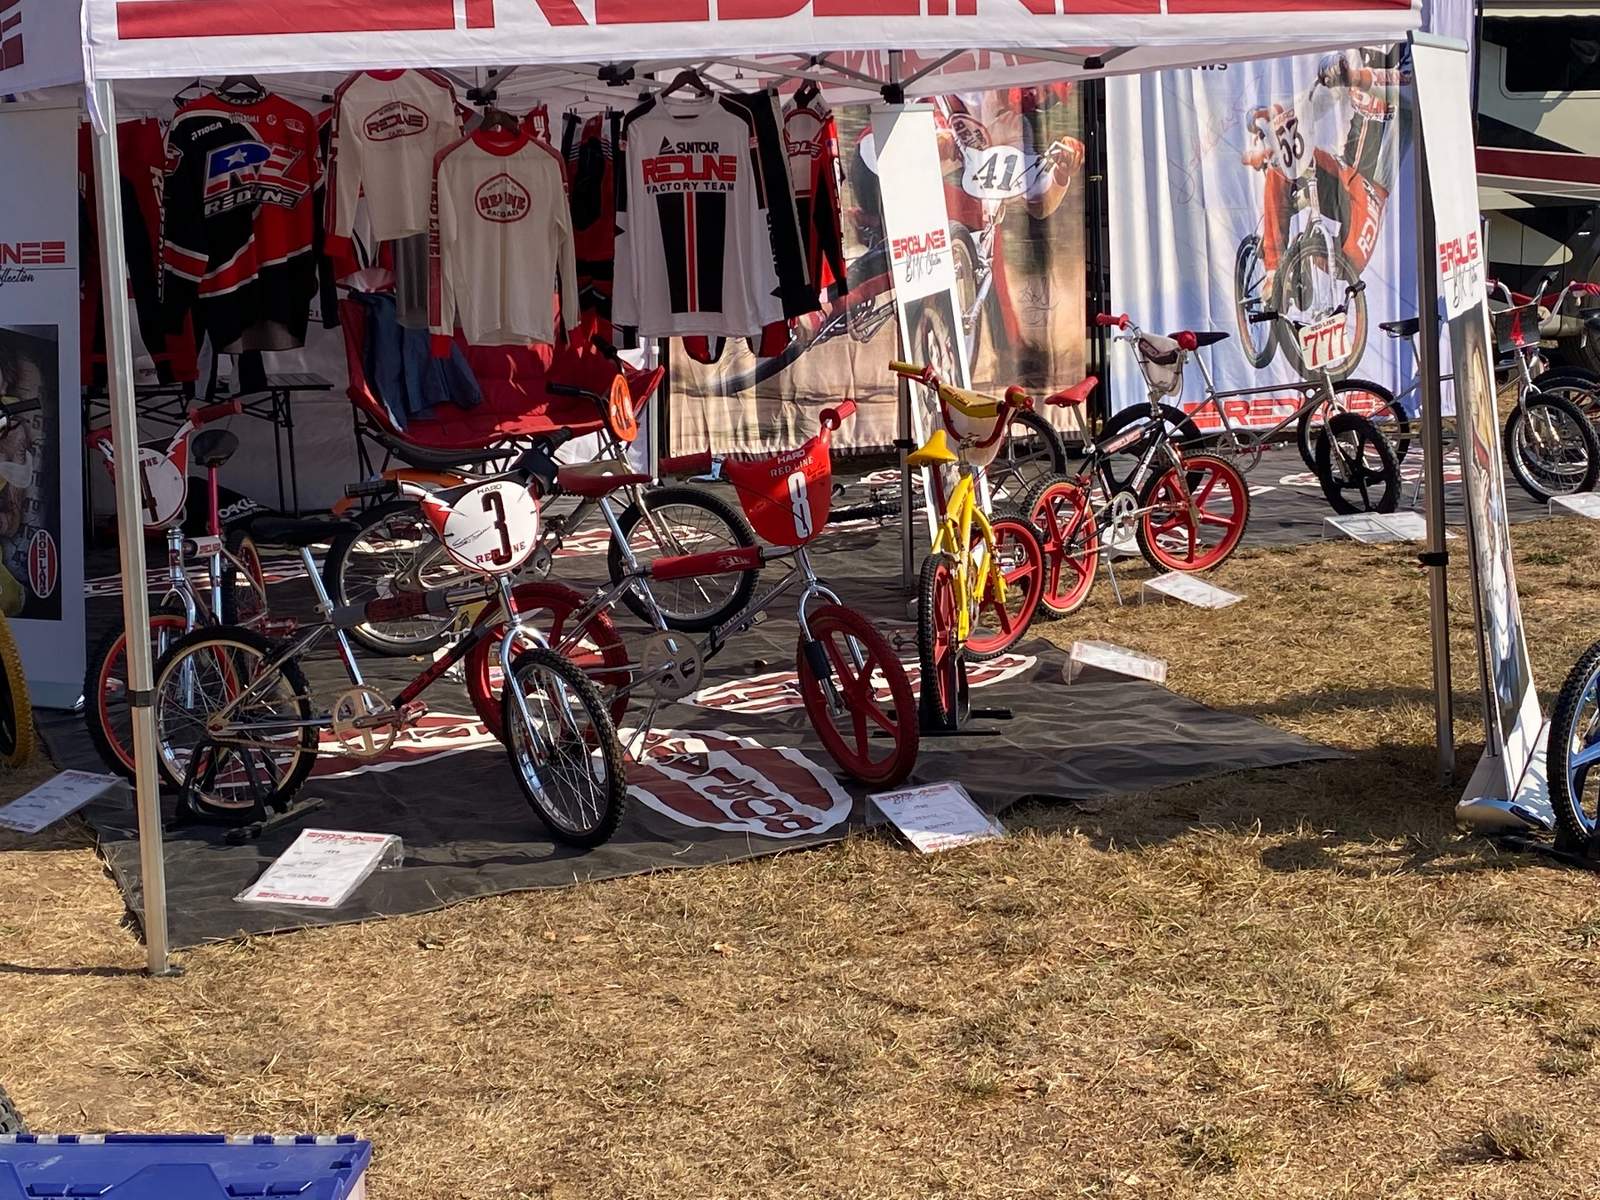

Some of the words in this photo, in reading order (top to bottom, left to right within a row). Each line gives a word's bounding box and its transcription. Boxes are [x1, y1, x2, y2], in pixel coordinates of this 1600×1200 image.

[676, 141, 719, 155] SUNTOUR
[642, 155, 737, 185] REDLINE
[977, 152, 1018, 192] 41
[203, 187, 297, 217] REDINE
[646, 182, 699, 195] FACTORY
[704, 181, 735, 192] TEAM
[1303, 323, 1346, 367] 777
[787, 471, 813, 539] 8
[481, 490, 513, 566] 3
